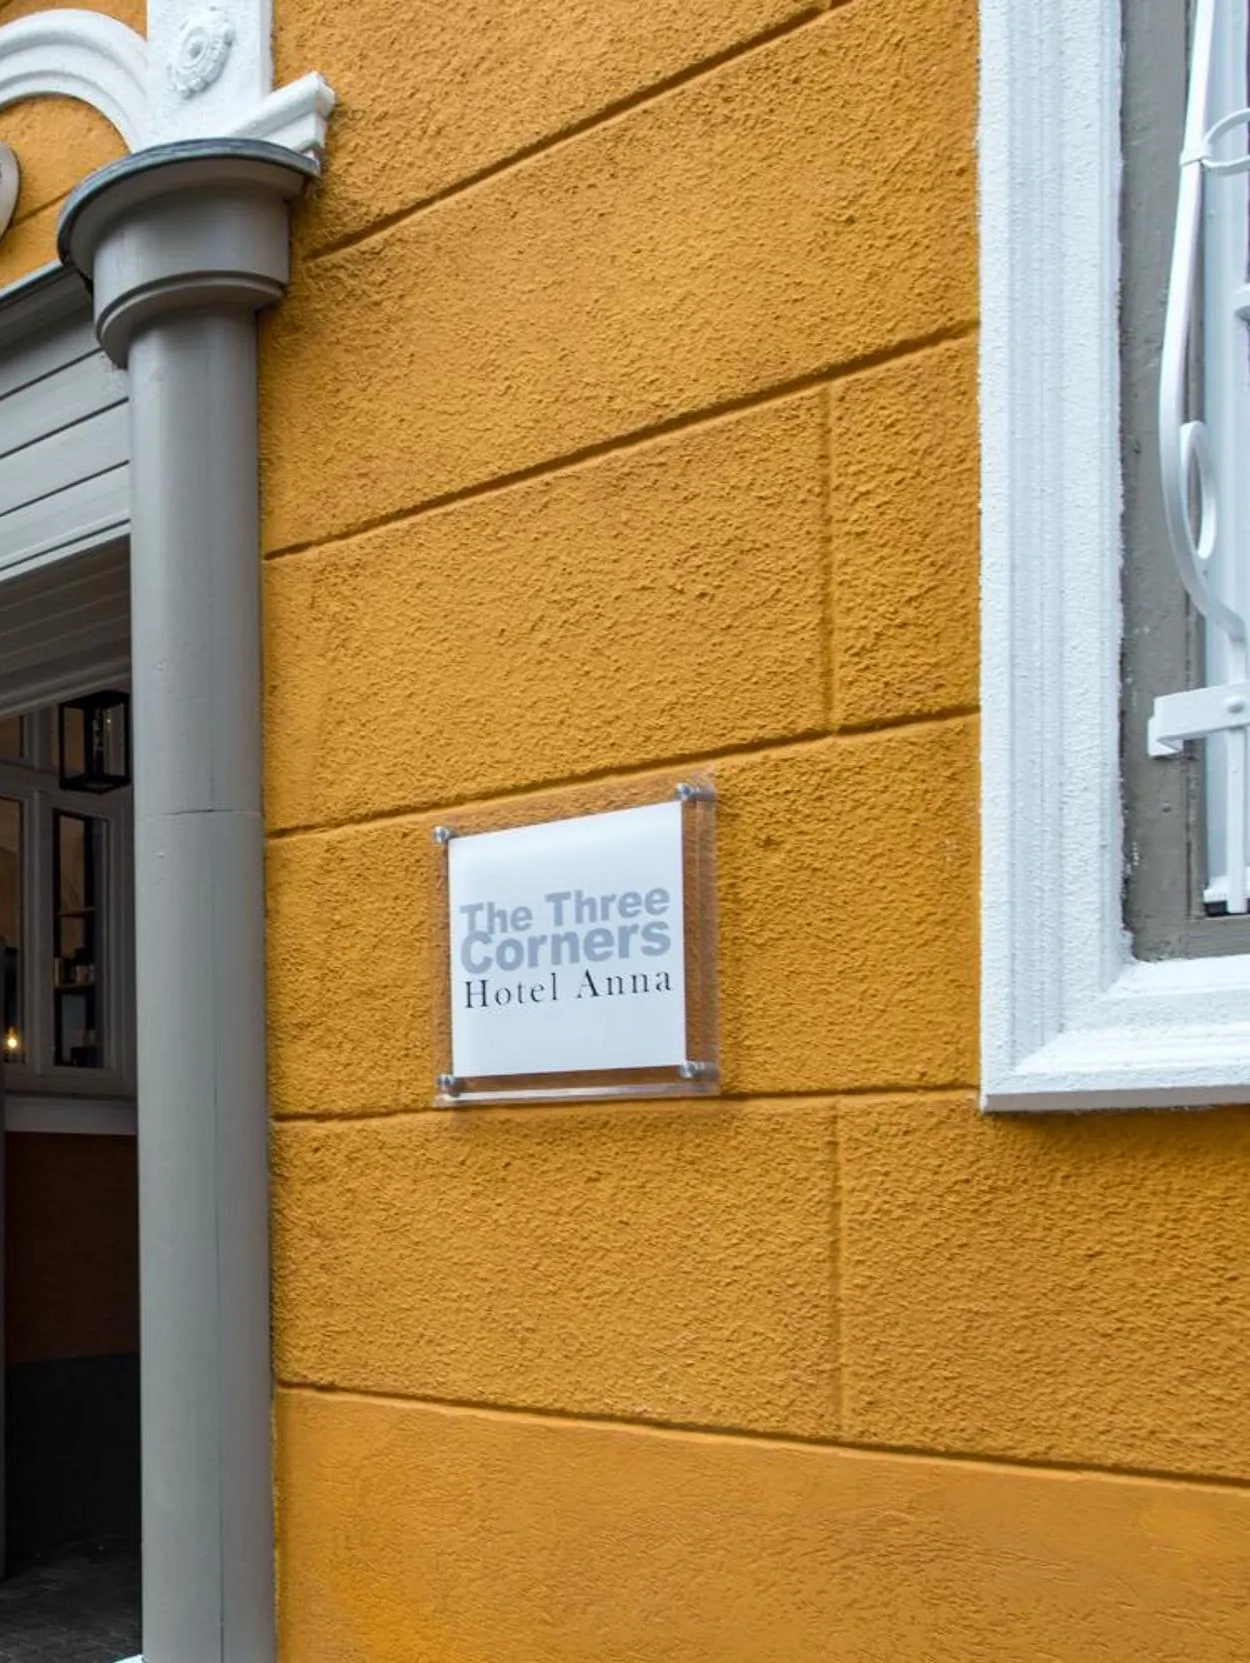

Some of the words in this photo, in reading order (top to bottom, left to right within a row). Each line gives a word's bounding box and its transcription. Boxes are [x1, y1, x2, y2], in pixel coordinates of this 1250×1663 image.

[461, 902, 532, 934] The
[546, 888, 670, 926] Three
[461, 921, 671, 973] Corners
[465, 973, 557, 1008] Hotel
[577, 969, 672, 998] Anna
